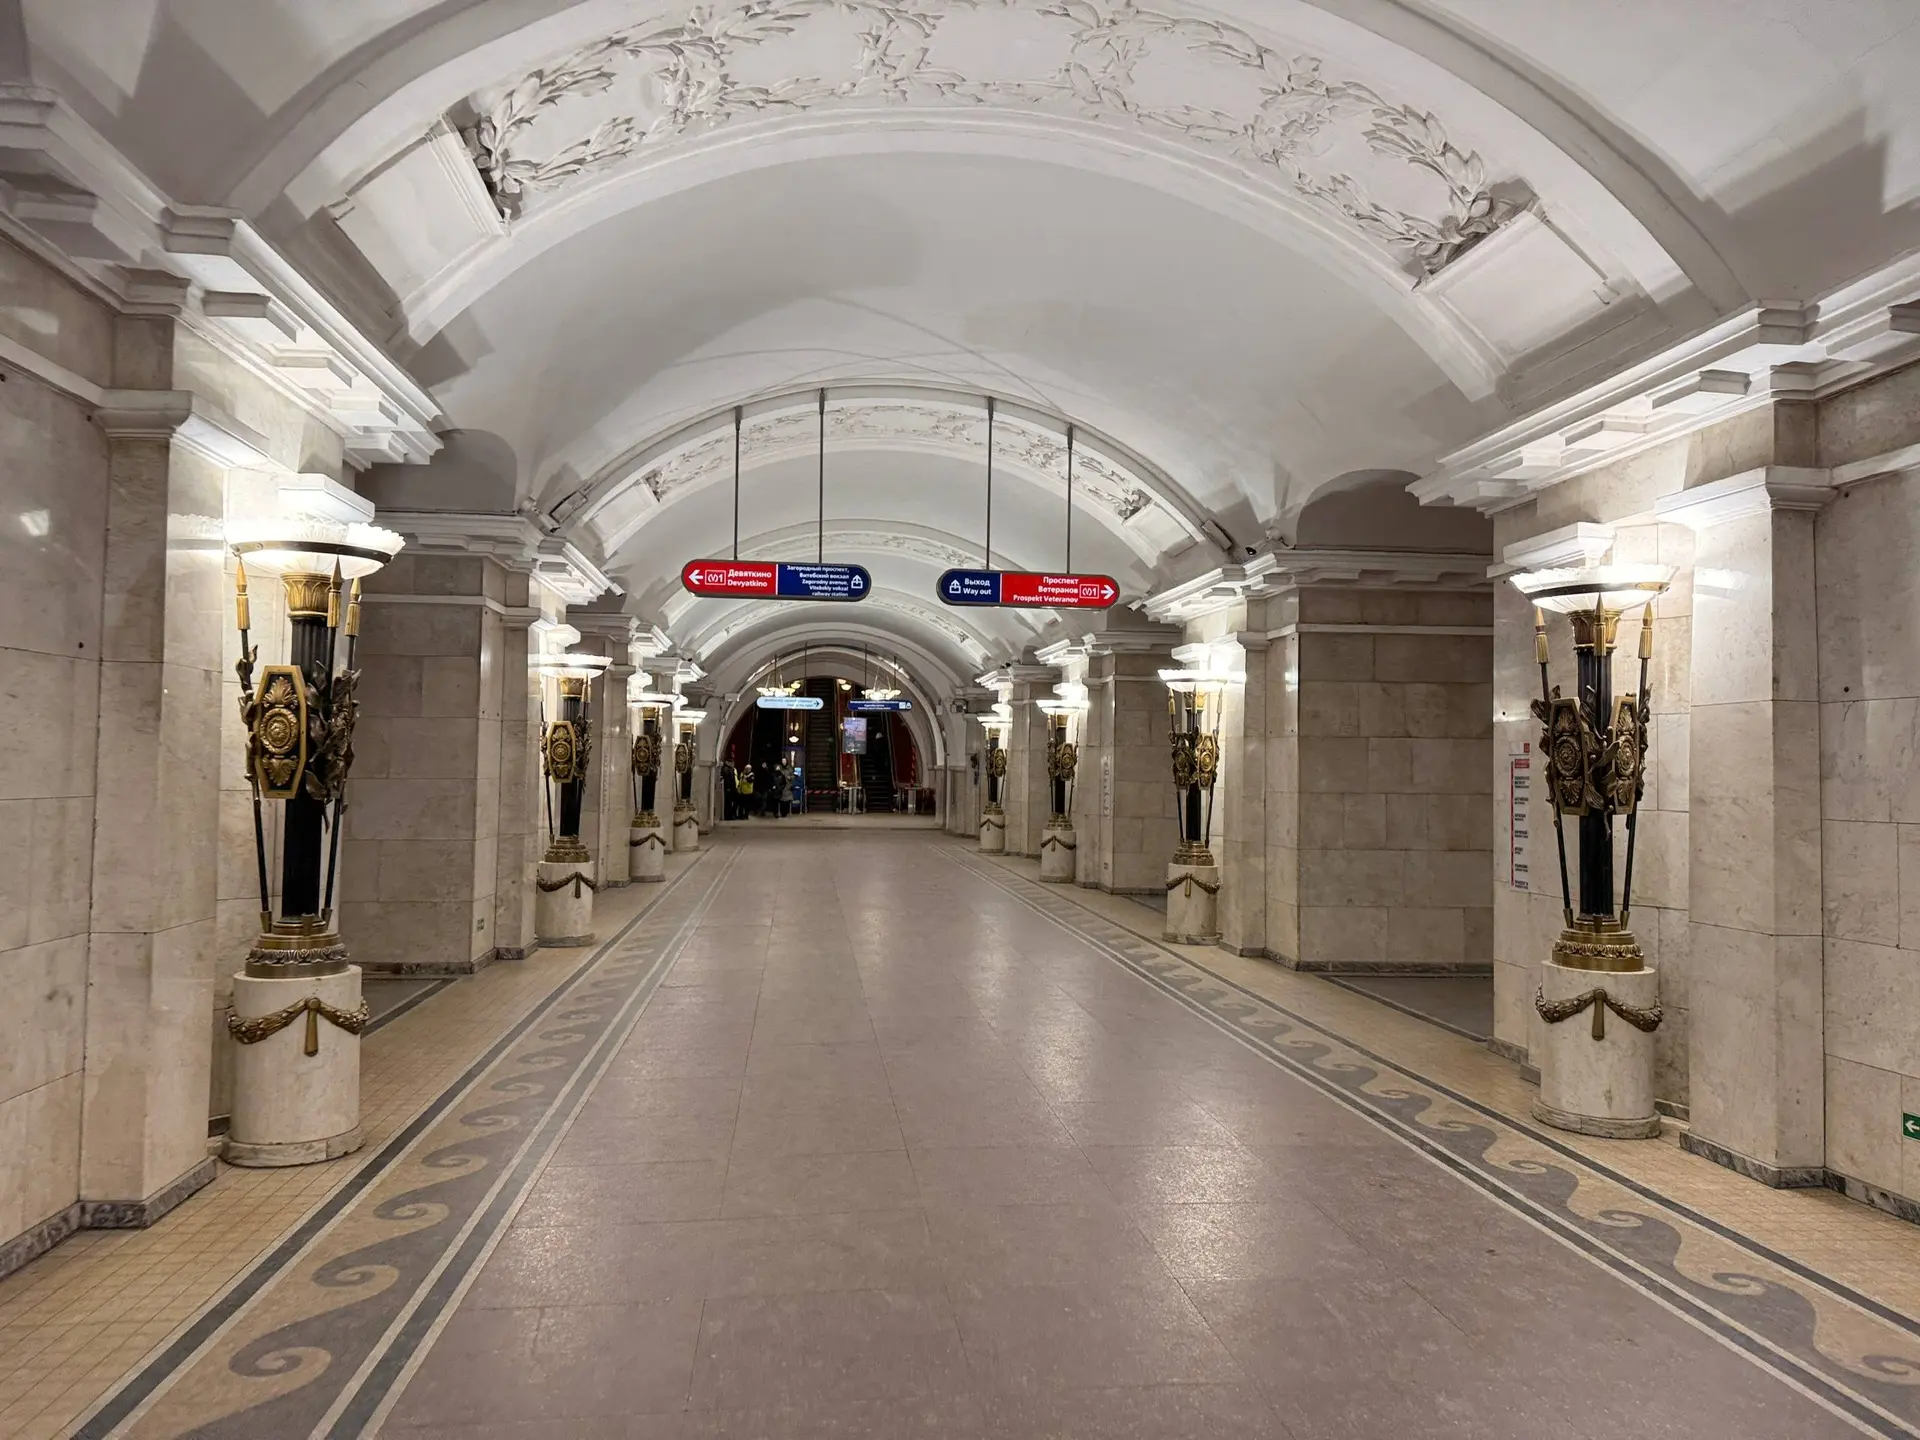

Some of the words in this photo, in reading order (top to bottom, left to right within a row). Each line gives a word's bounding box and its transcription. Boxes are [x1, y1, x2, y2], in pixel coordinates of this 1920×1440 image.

[728, 569, 772, 578] Девяткино
[728, 579, 767, 588] Devyatkino
[964, 578, 990, 586] Выход
[1043, 576, 1079, 585] Проспект
[963, 587, 978, 596] Way
[1038, 586, 1079, 594] Ветеранов
[1013, 594, 1042, 603] Prospekt
[1044, 595, 1078, 604] Veteranov
